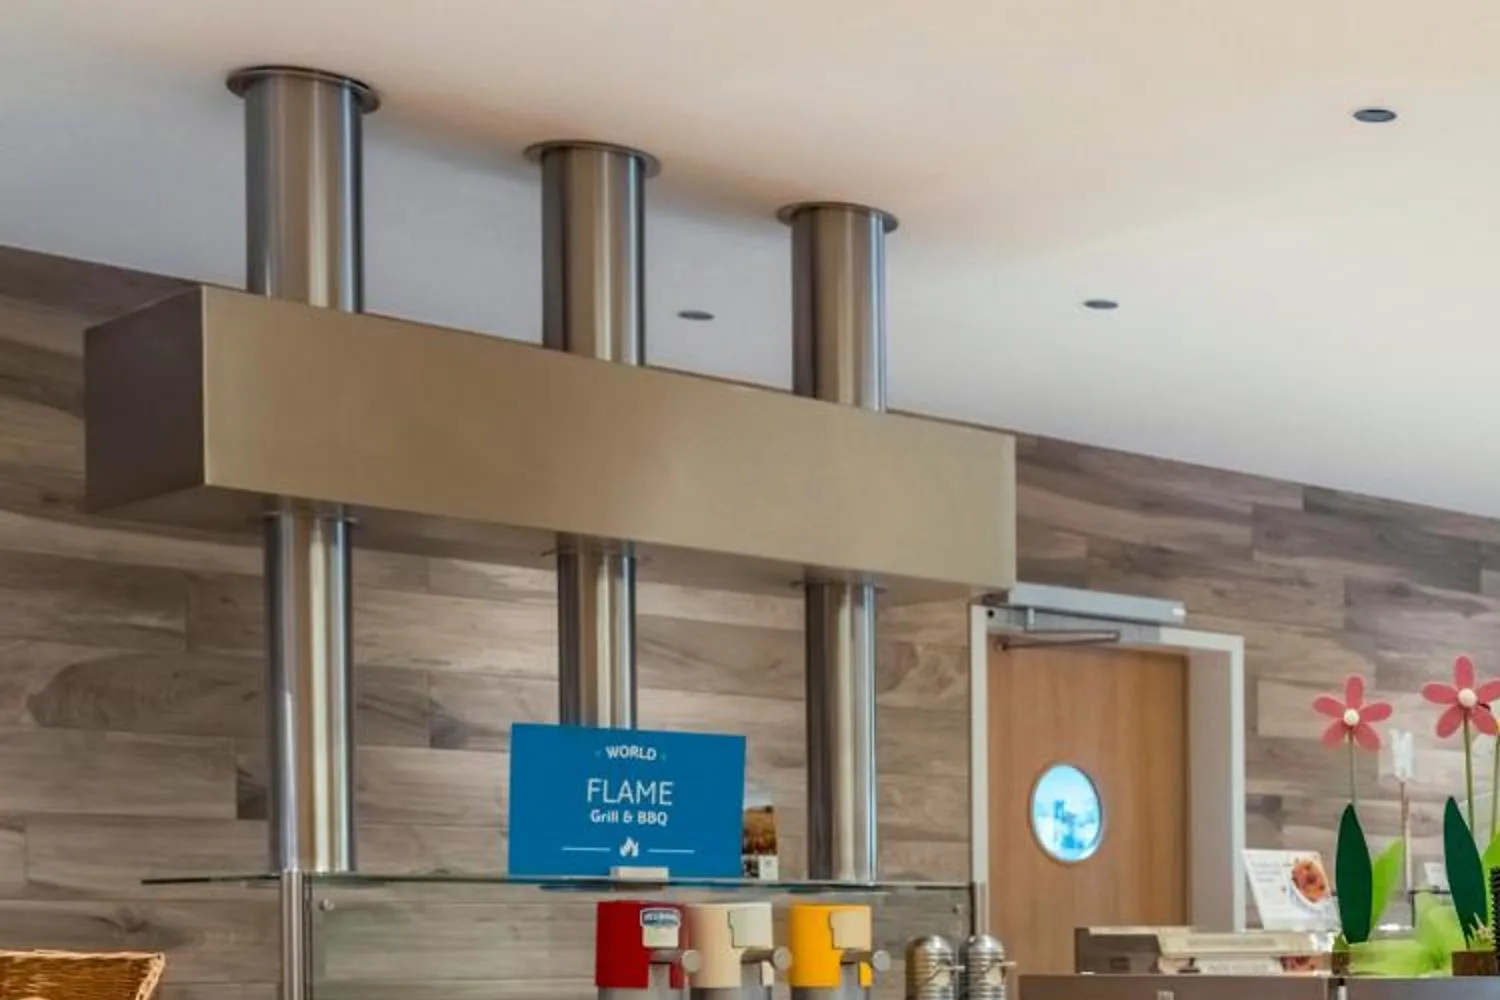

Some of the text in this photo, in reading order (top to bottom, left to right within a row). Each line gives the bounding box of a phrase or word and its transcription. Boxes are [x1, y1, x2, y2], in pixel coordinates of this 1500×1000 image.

[606, 745, 656, 760] WORLD
[587, 778, 673, 805] FLAME
[590, 809, 667, 826] Grill & BBQ
